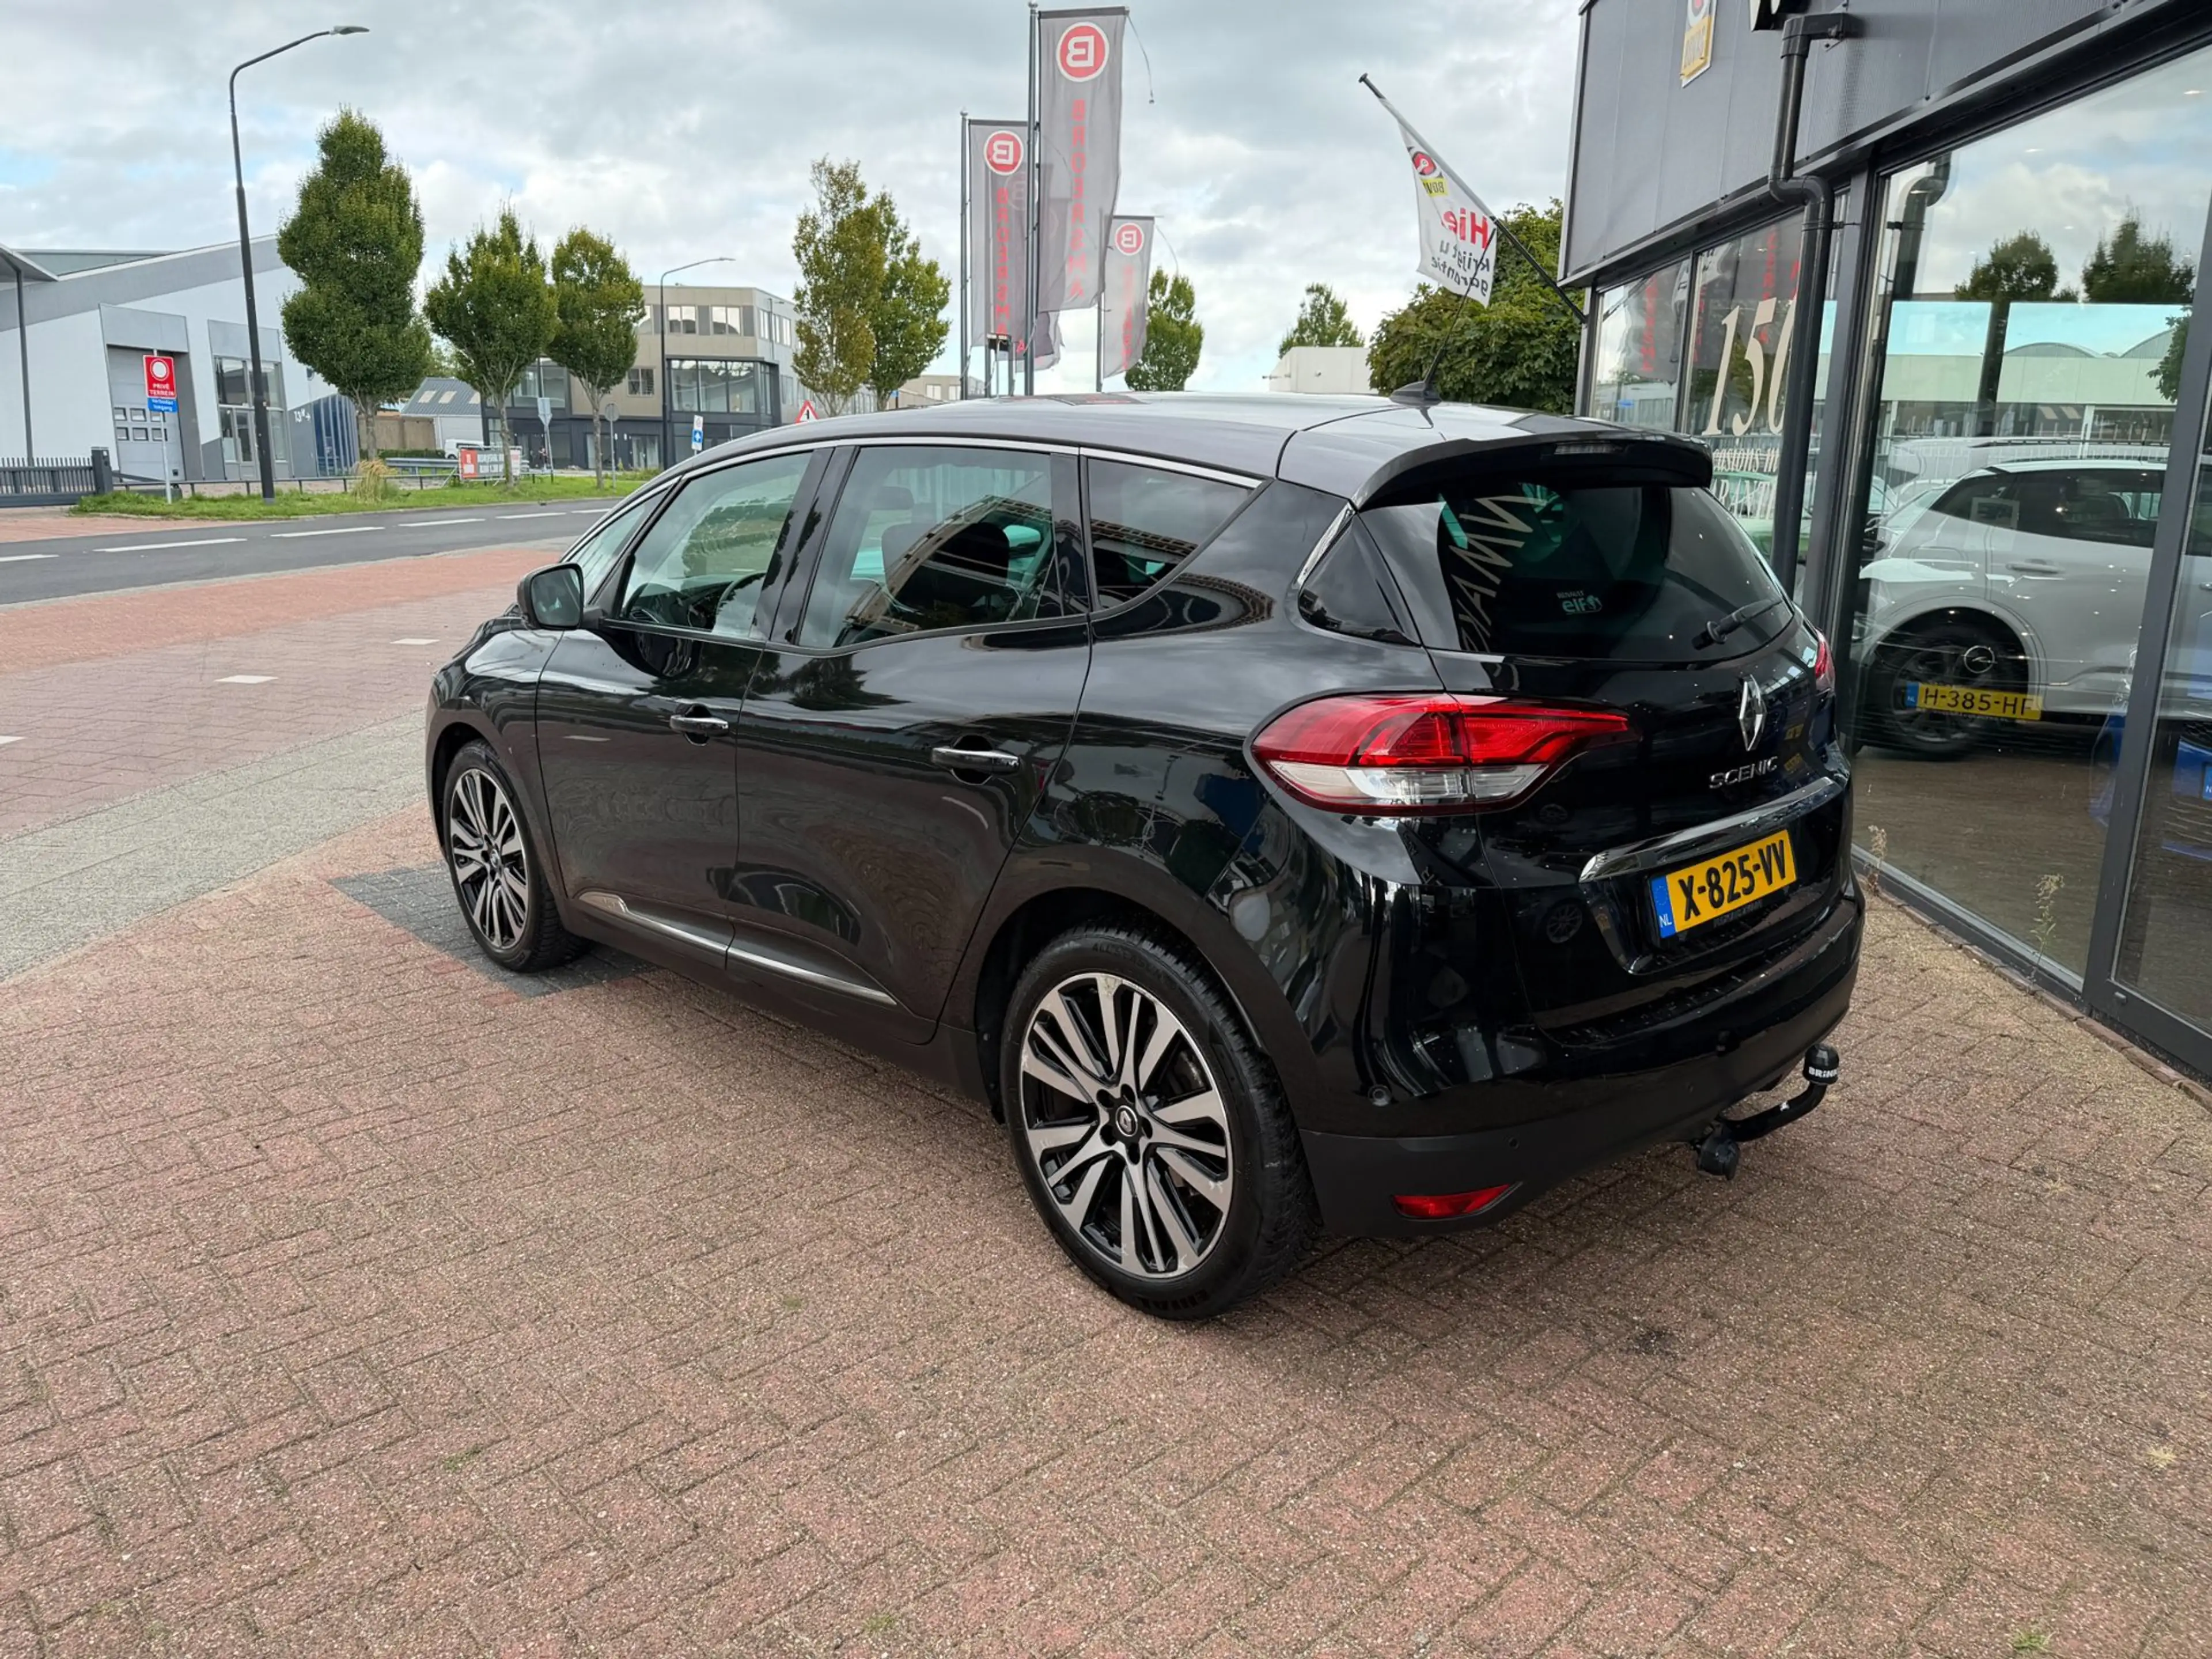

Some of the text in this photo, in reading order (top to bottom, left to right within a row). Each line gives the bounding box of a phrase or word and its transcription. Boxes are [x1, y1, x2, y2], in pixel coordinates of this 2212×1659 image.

[1709, 756, 1778, 789] SCENIC
[1677, 839, 1786, 922] X-825-VV
[1659, 913, 1673, 928] NL
